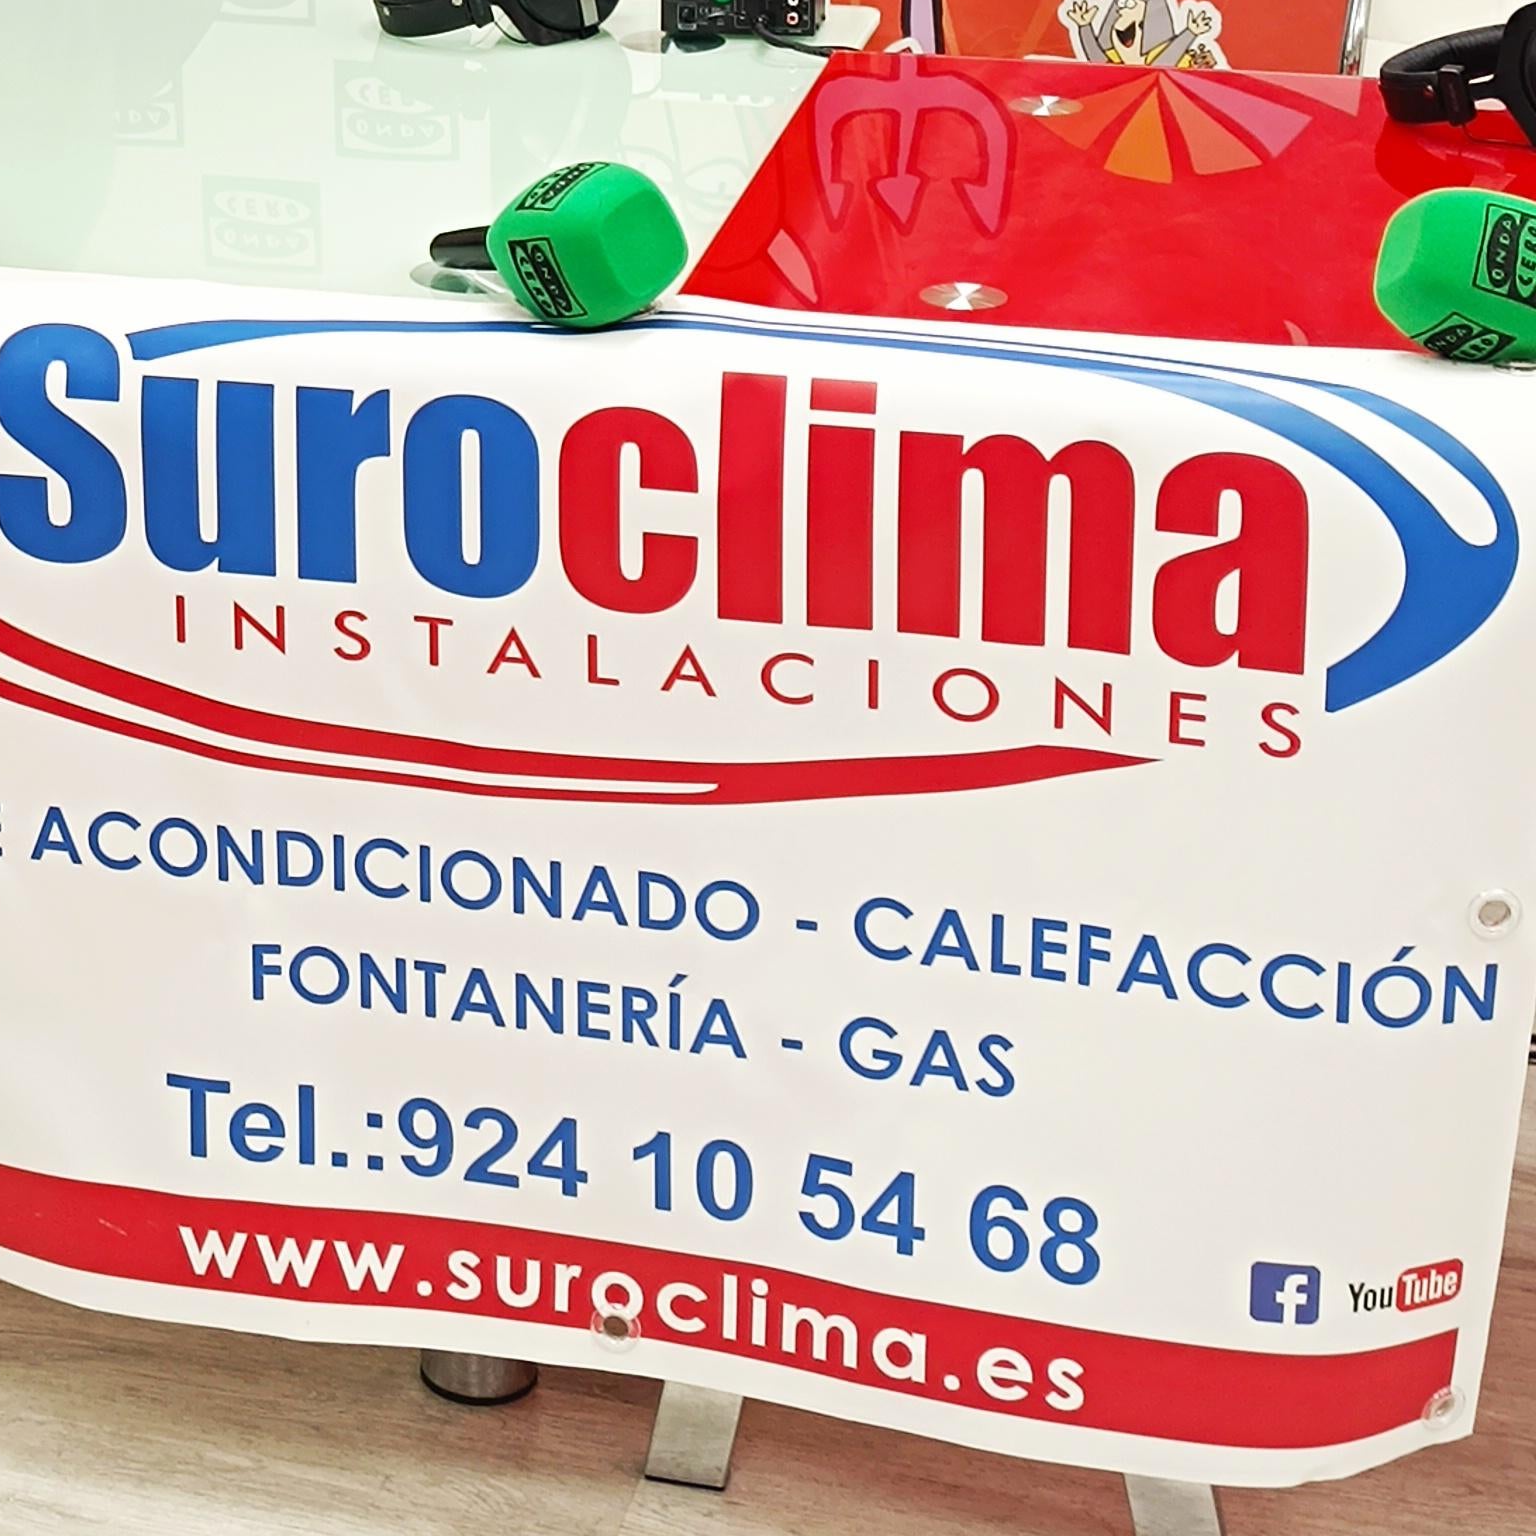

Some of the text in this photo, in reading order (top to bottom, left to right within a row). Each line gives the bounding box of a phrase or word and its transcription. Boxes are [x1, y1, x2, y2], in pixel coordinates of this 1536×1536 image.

[1491, 220, 1513, 280] ONDA
[175, 595, 1302, 759] INSTALACIONES
[31, 807, 759, 941] ACONDICIONADO
[854, 897, 1498, 1028] CALEFACCIÓN
[252, 944, 747, 1059] FONTANERÍA
[839, 1017, 1015, 1097] GAS
[166, 1074, 1101, 1286] Tel.:924 10 54 68
[179, 1225, 1085, 1412] www.suroclima.es
[1348, 1268, 1458, 1313] YouTube
